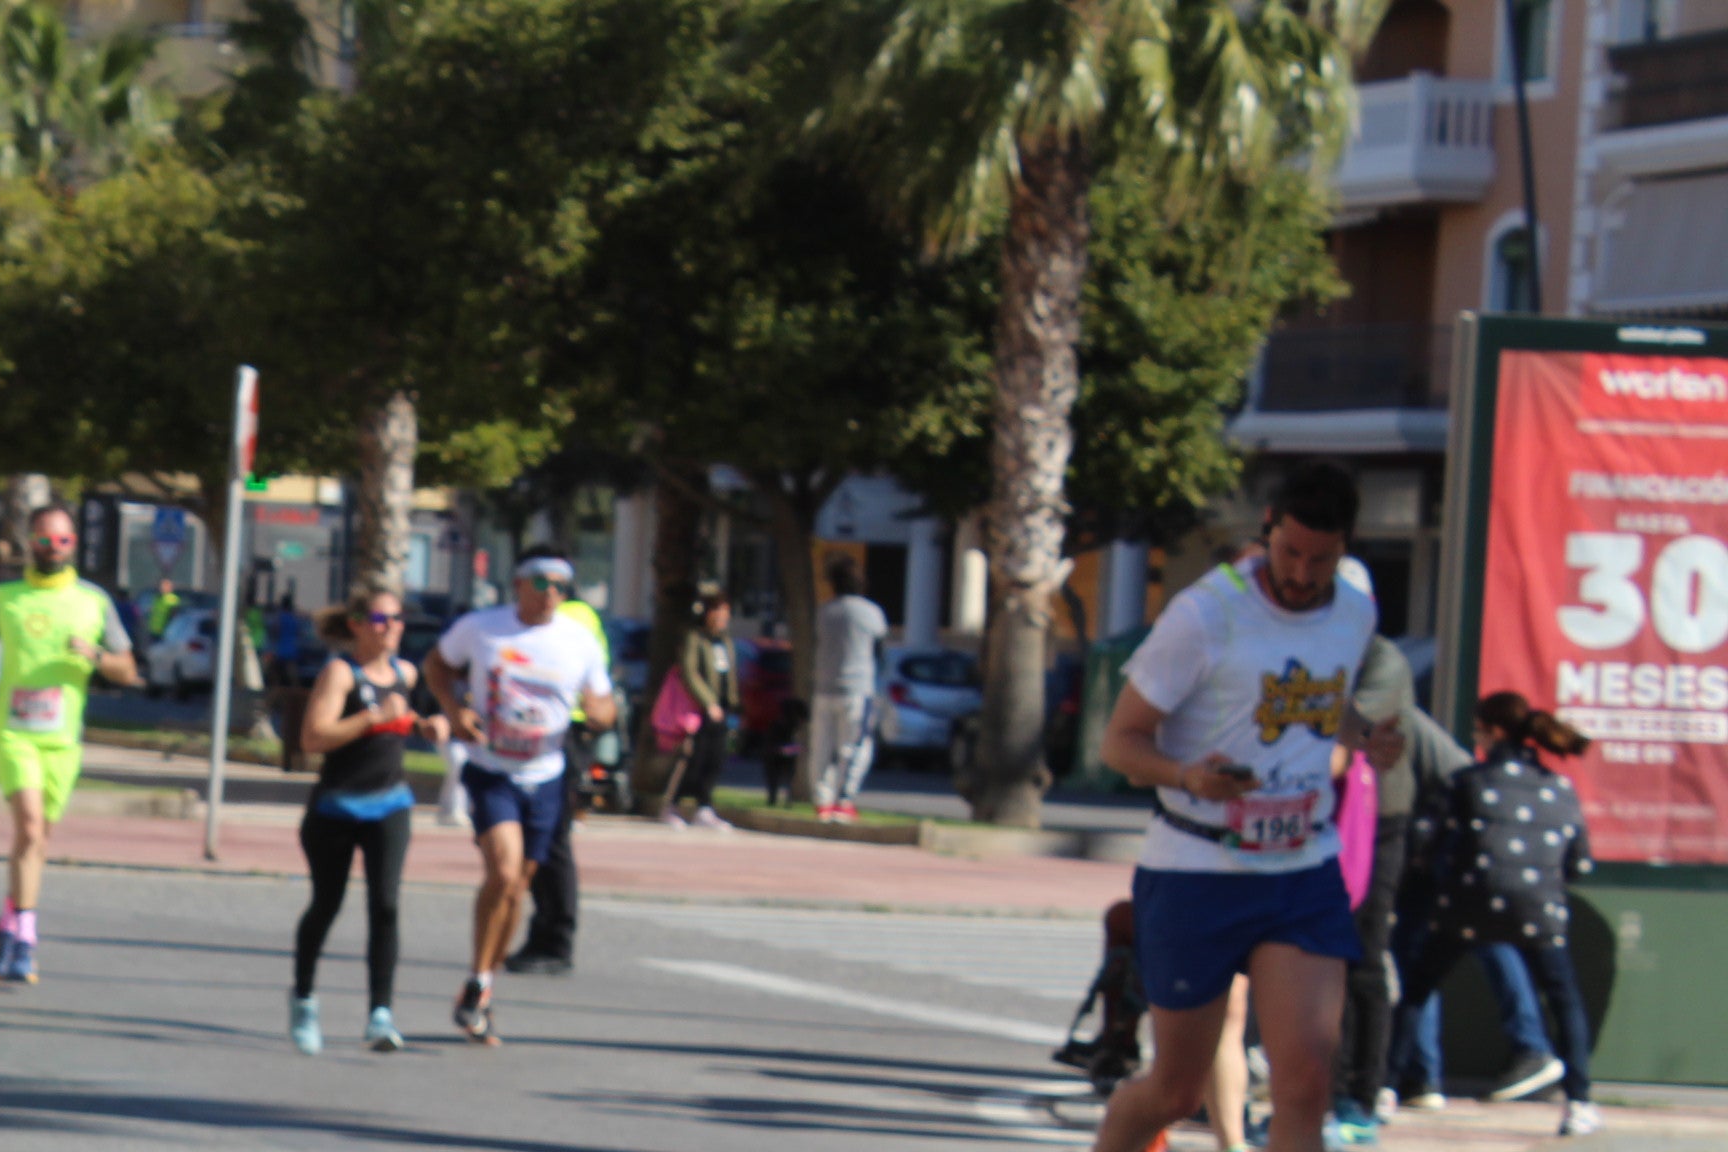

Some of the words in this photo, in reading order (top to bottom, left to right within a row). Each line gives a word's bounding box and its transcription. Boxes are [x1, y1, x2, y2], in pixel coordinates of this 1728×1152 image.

[1600, 365, 1727, 402] worten
[1569, 470, 1728, 505] FINANCIACIÓ
[1557, 531, 1728, 654] 30
[1557, 660, 1728, 710] MESES
